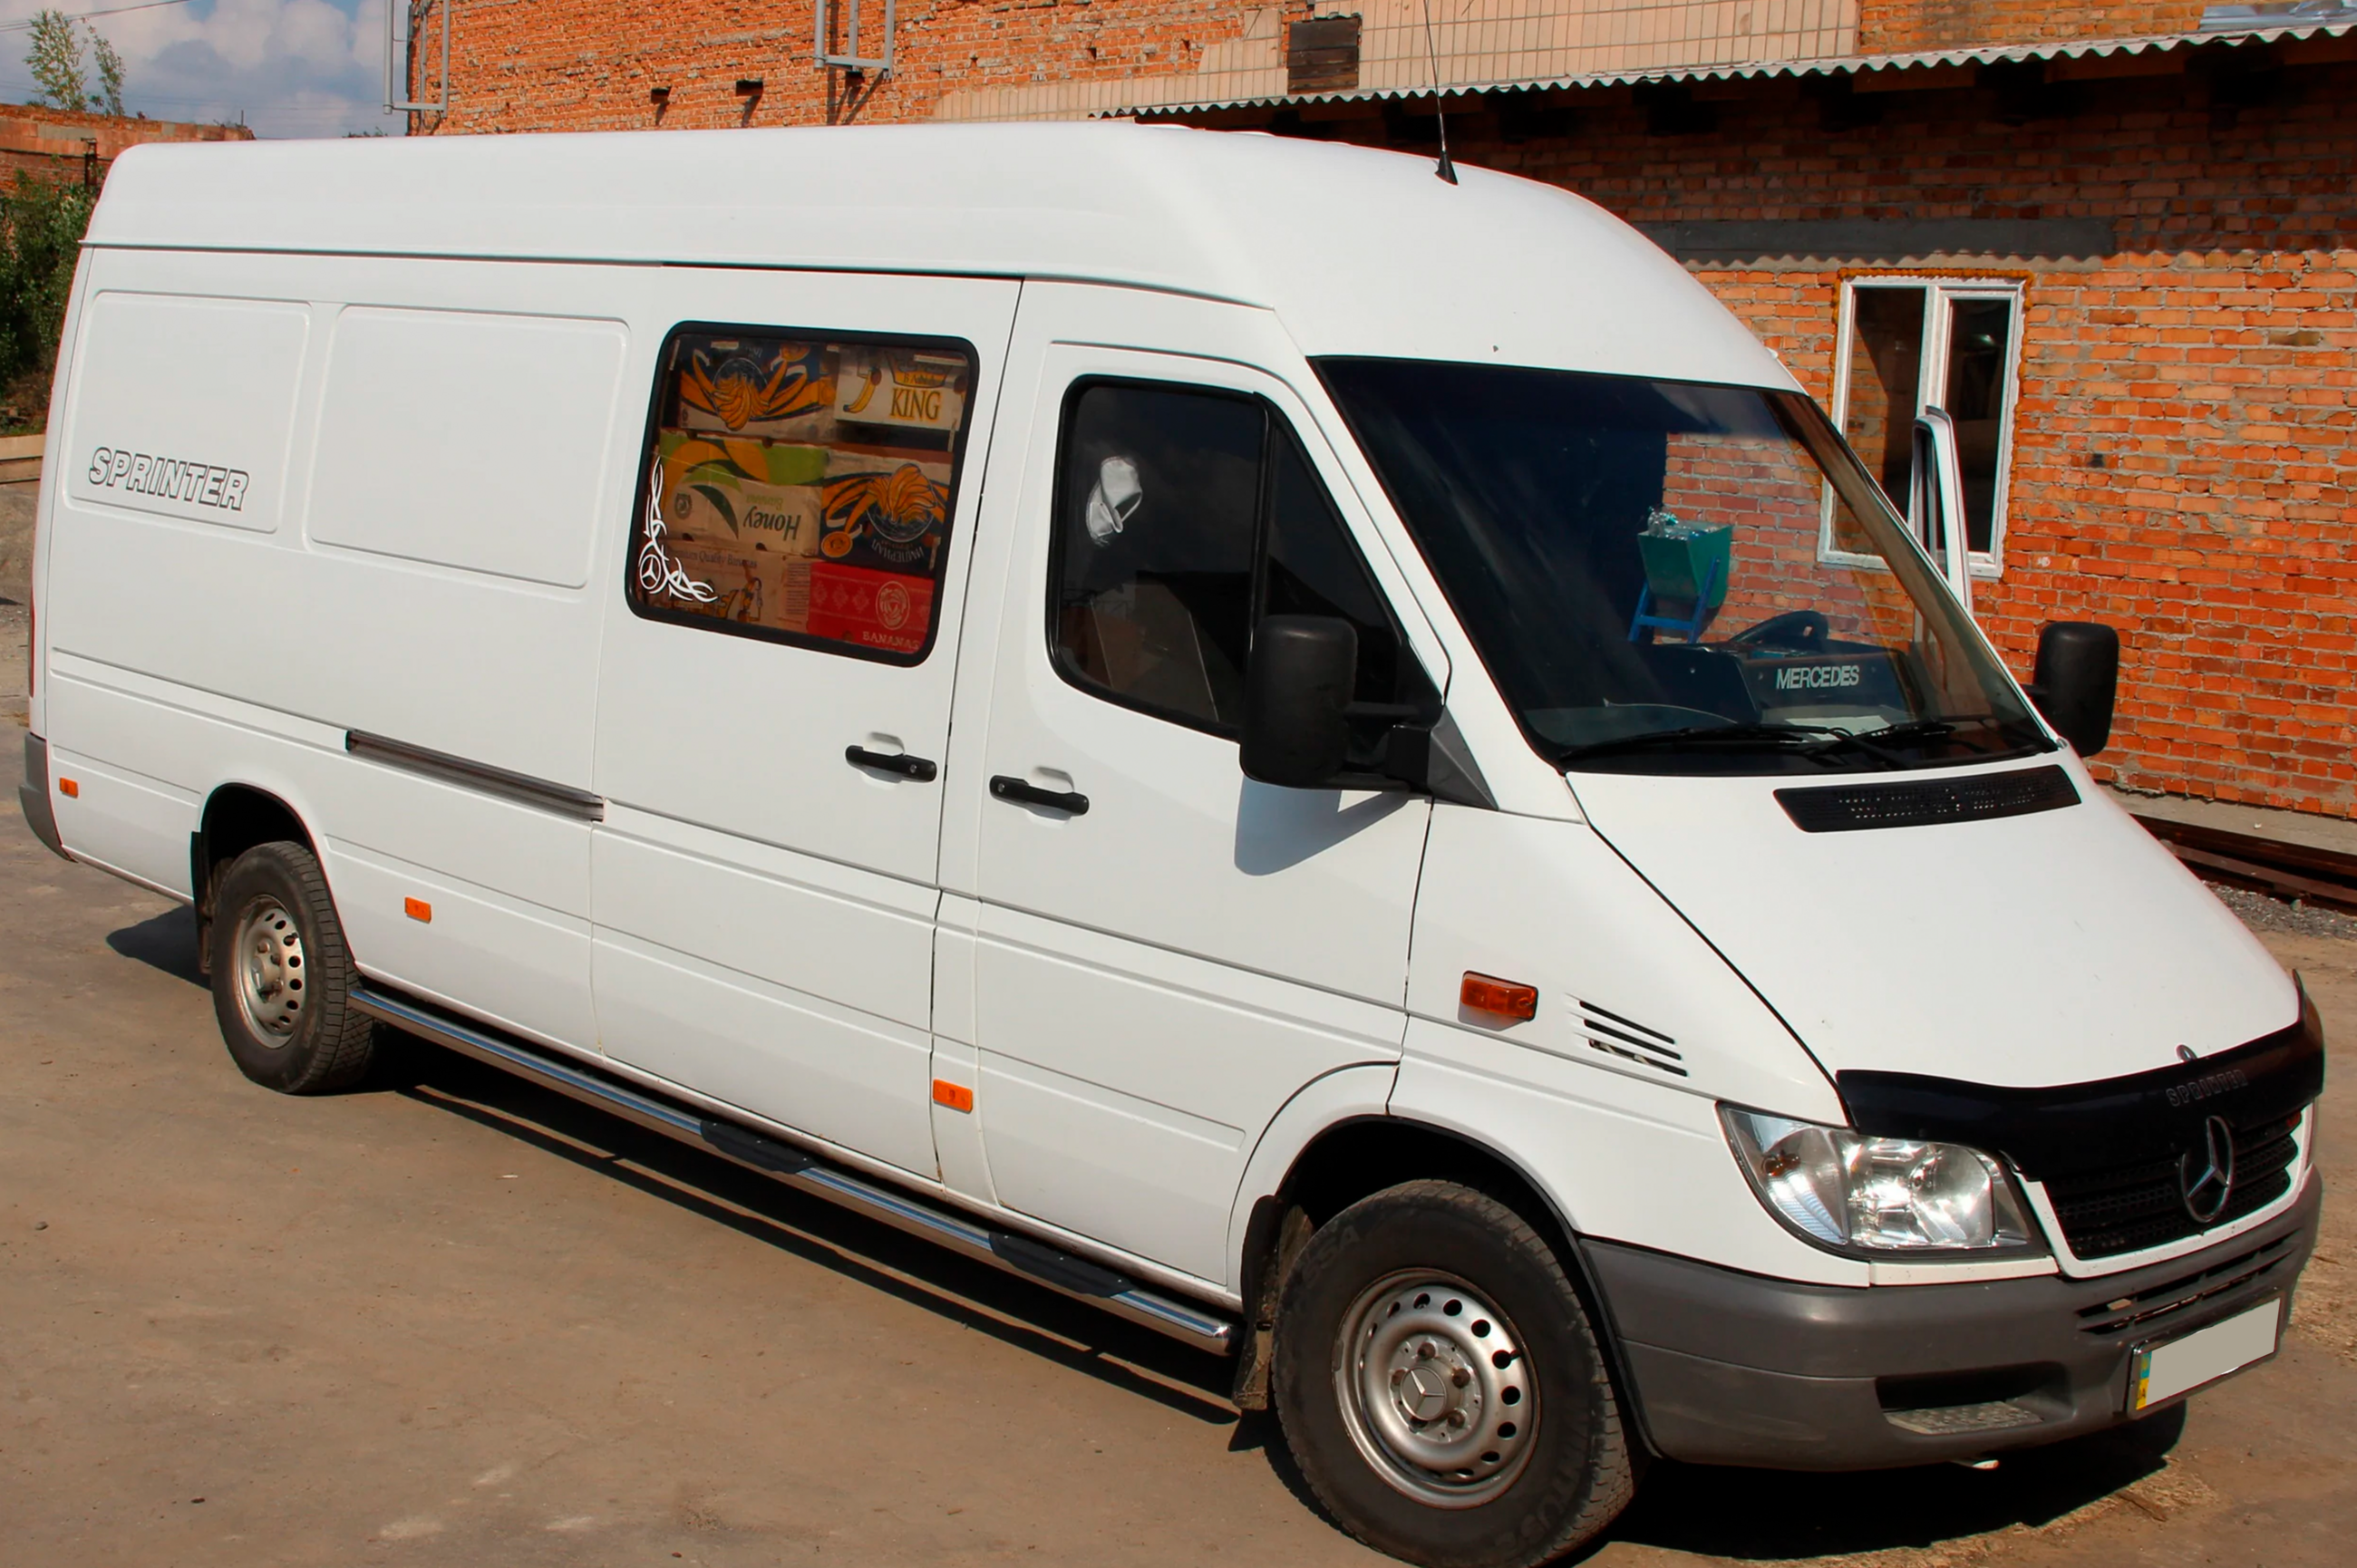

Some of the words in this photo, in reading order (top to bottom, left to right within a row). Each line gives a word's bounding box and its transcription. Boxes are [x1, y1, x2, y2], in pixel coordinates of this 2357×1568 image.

[889, 387, 942, 421] KING
[88, 446, 250, 511] SPRINTER
[742, 506, 802, 542] Honey
[861, 630, 921, 651] BANANAS
[1776, 664, 1860, 690] MERCEDES
[2165, 1068, 2249, 1108] SPRINTER
